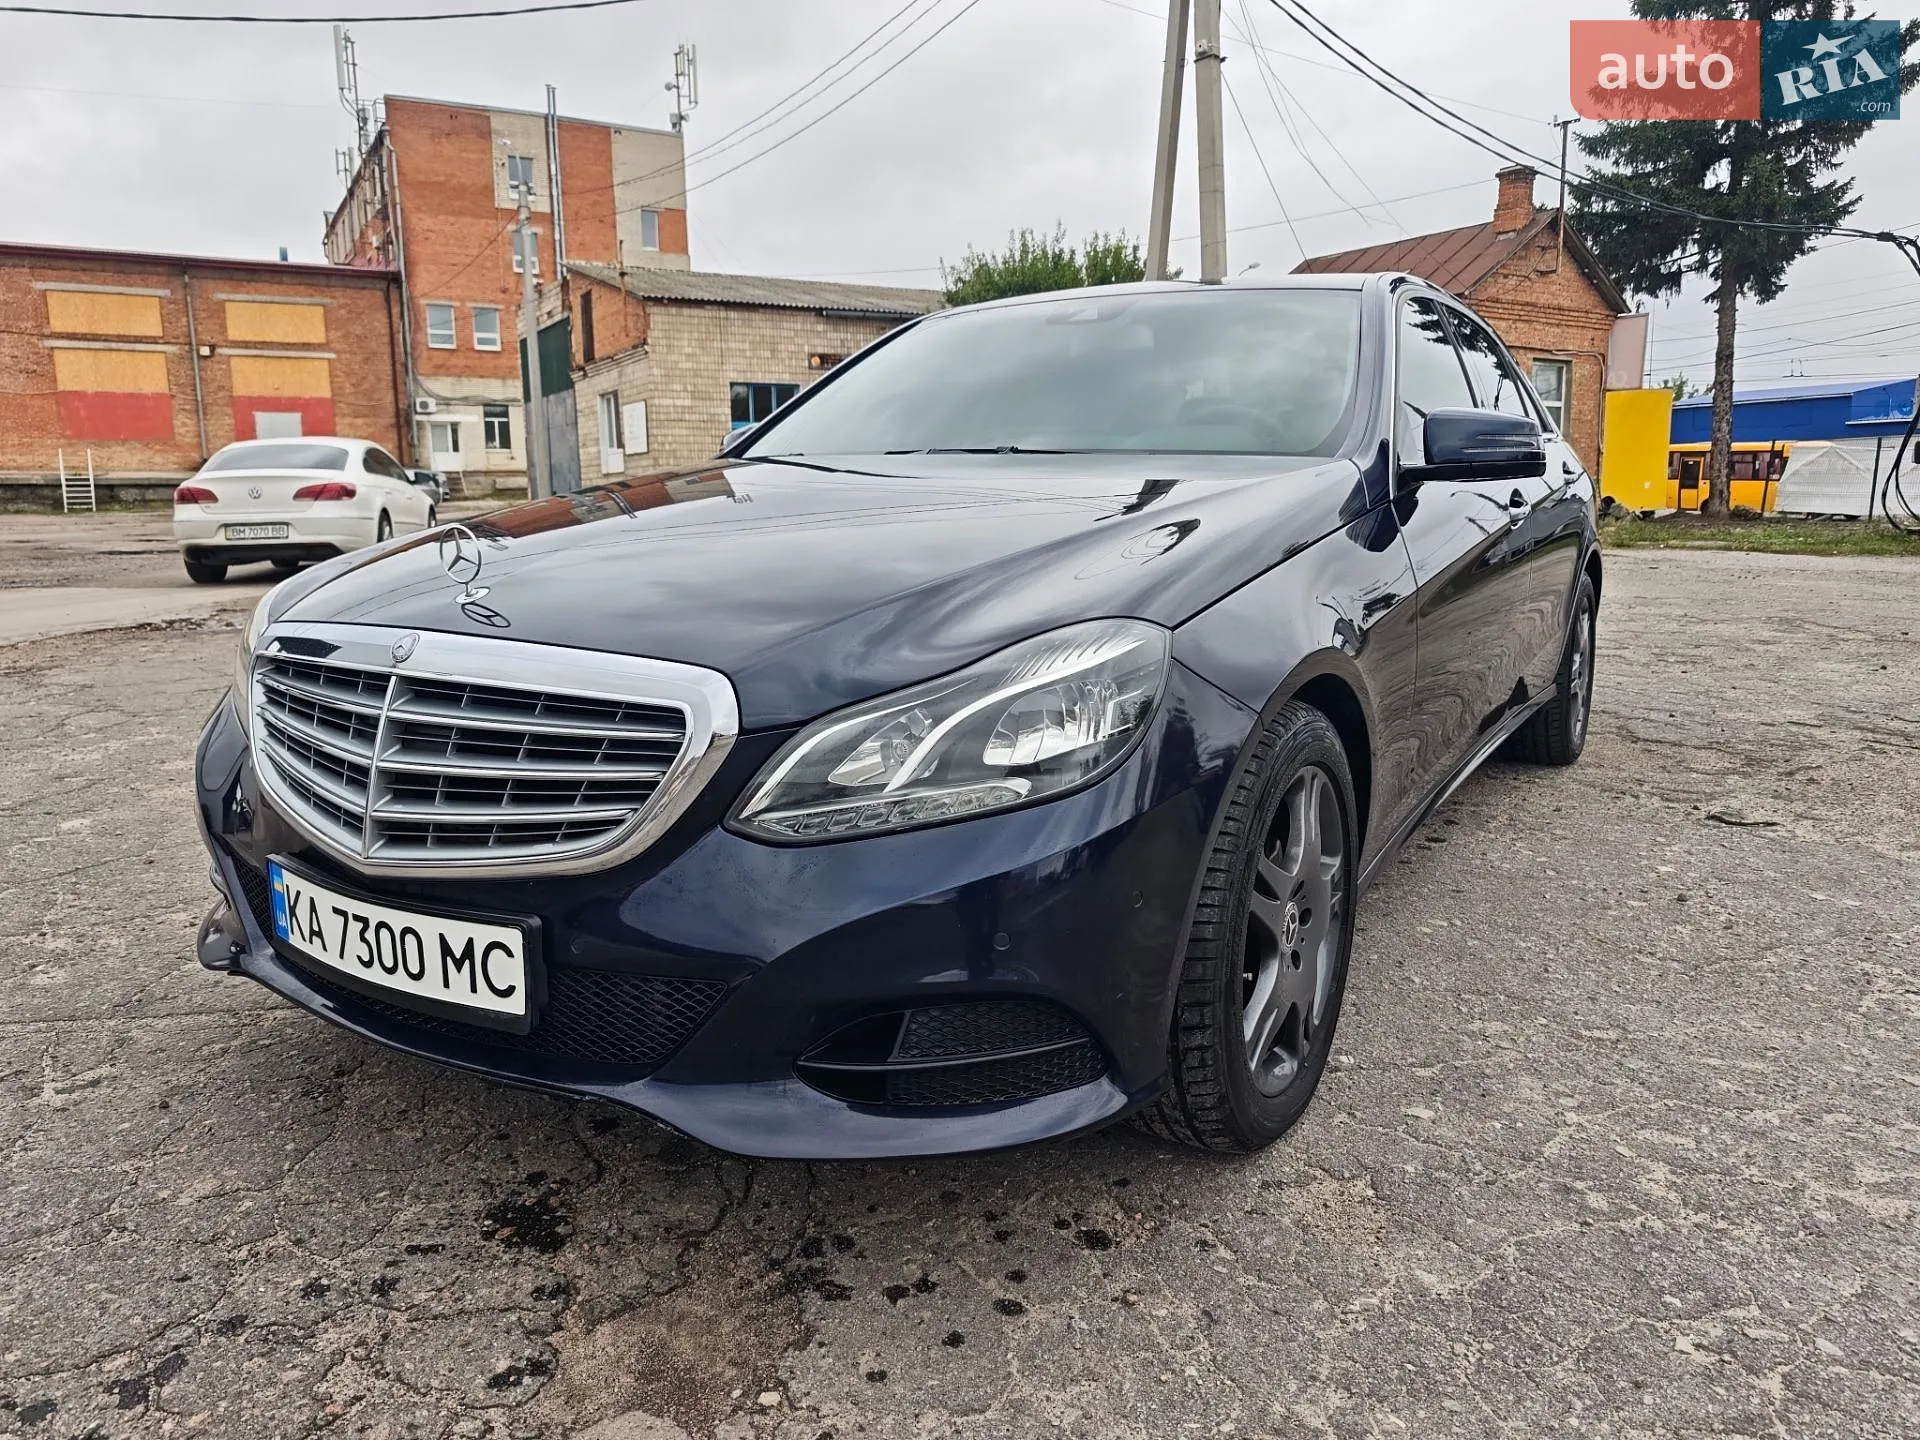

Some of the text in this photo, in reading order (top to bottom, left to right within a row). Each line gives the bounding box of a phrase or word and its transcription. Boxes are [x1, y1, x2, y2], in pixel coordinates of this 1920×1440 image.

[232, 527, 245, 537] BM
[248, 526, 269, 537] 7070
[276, 909, 288, 929] UA
[285, 884, 517, 998] KA 7300 MC
